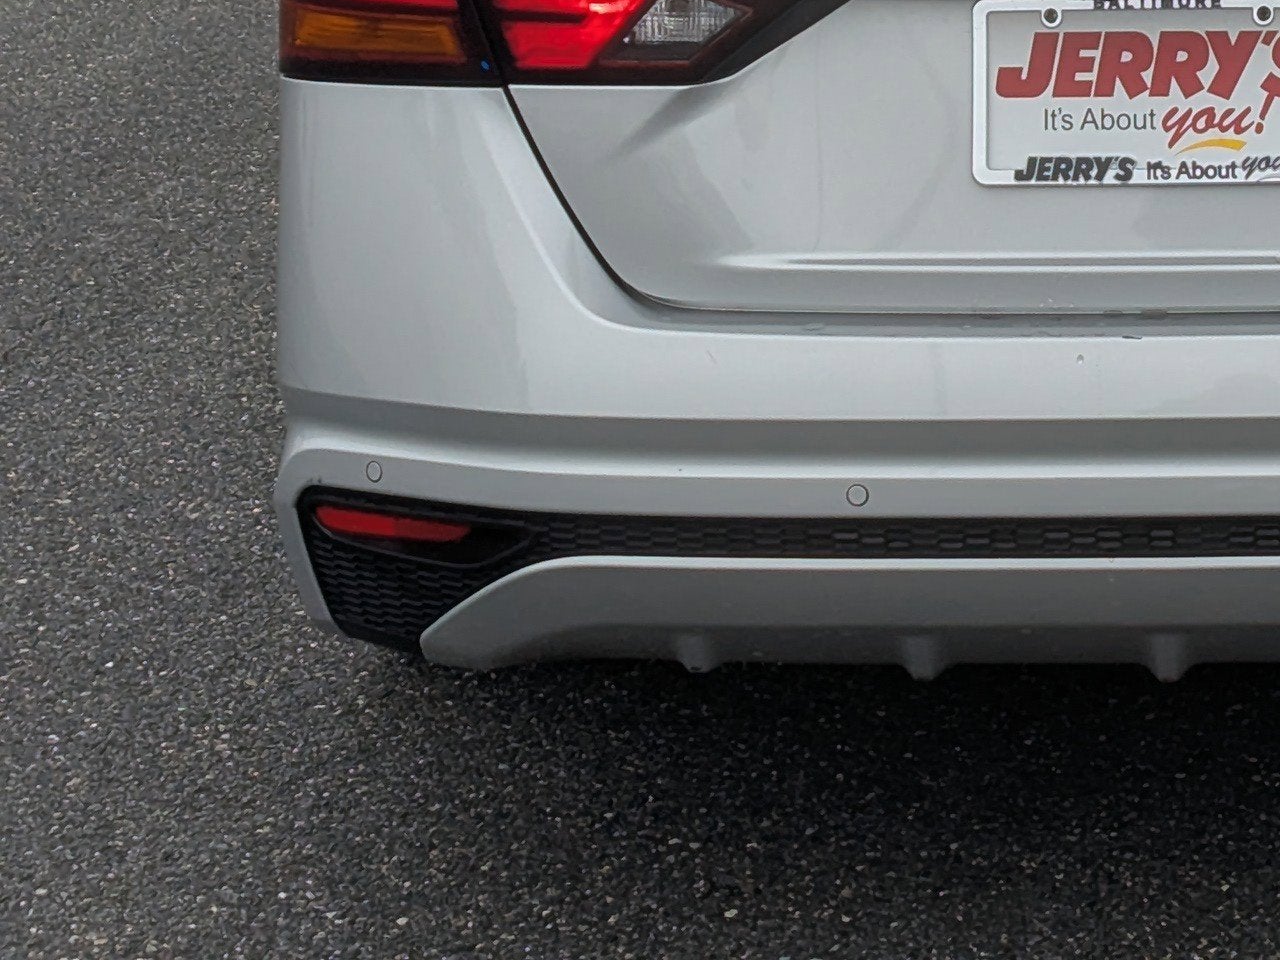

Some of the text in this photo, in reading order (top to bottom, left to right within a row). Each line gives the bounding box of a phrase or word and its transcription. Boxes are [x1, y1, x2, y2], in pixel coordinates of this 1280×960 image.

[1044, 93, 1274, 149] It's About you!
[1014, 155, 1137, 182] JERRY'S
[1146, 160, 1172, 180] It's
[1176, 160, 1237, 180] About
